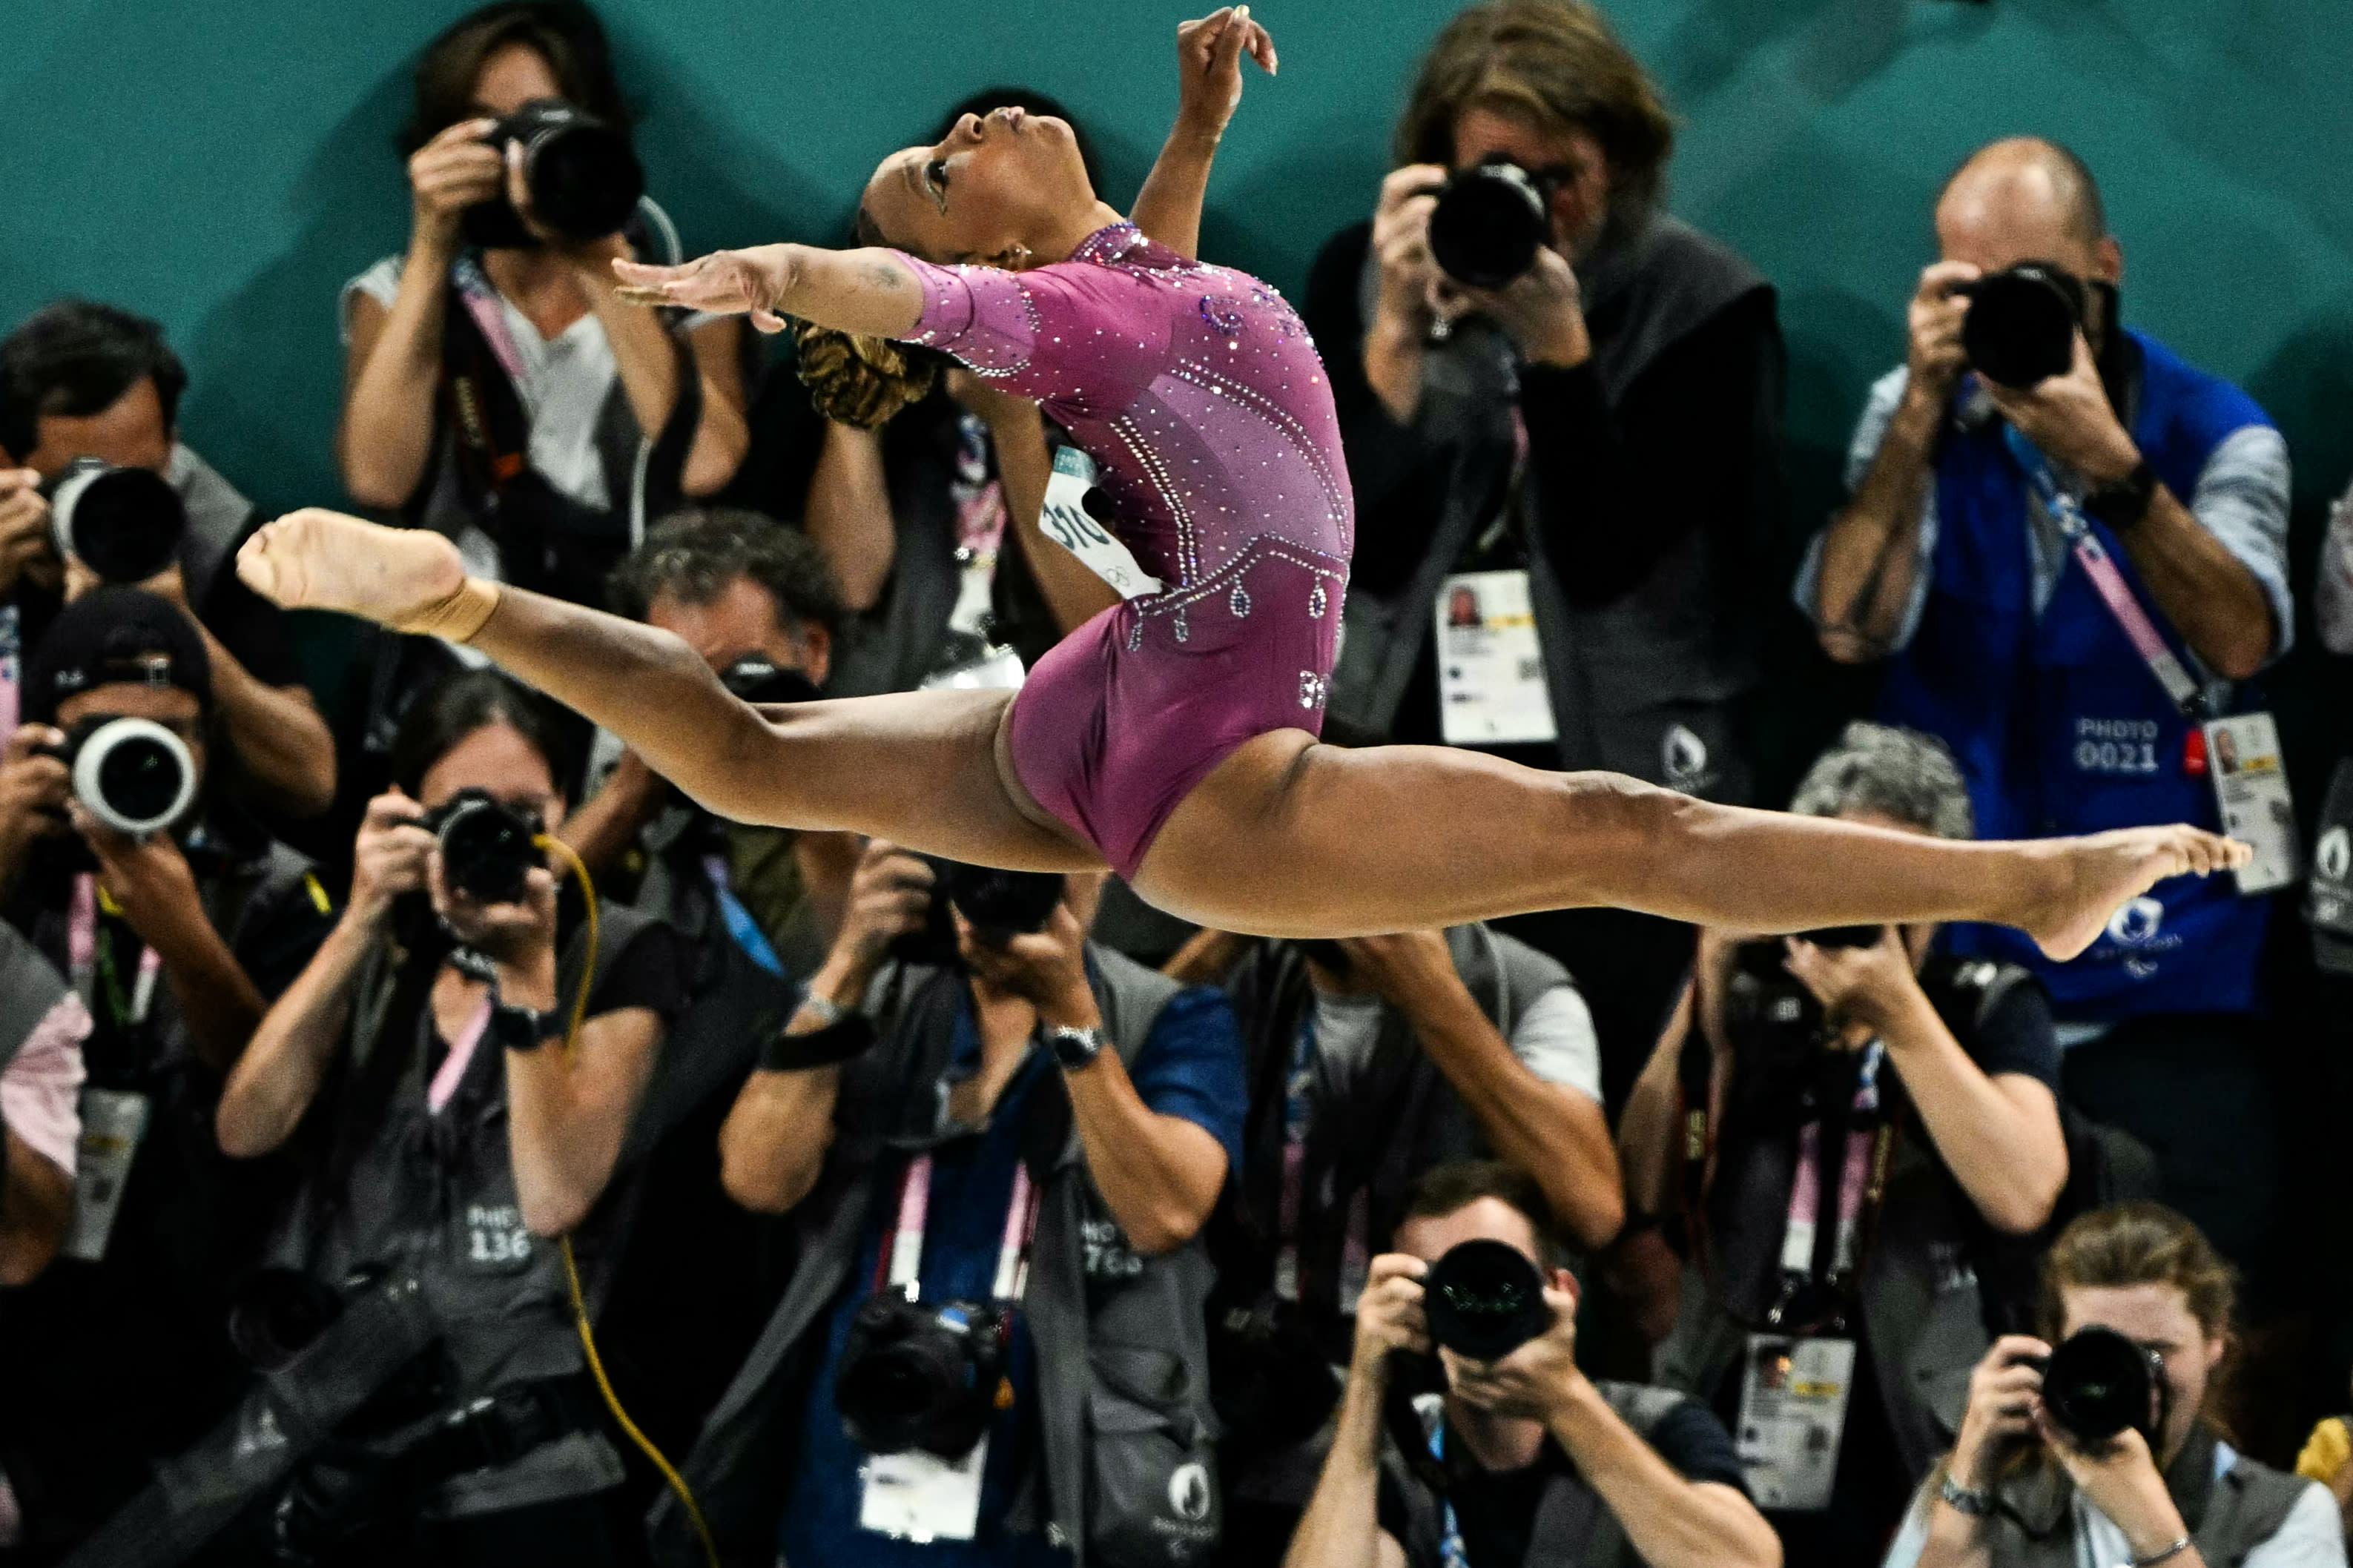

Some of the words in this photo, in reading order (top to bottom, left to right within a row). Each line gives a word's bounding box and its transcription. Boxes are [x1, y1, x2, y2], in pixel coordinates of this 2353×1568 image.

[1043, 504, 1110, 549] 310
[2079, 718, 2158, 738] PHOTO
[2076, 742, 2159, 772] 0021
